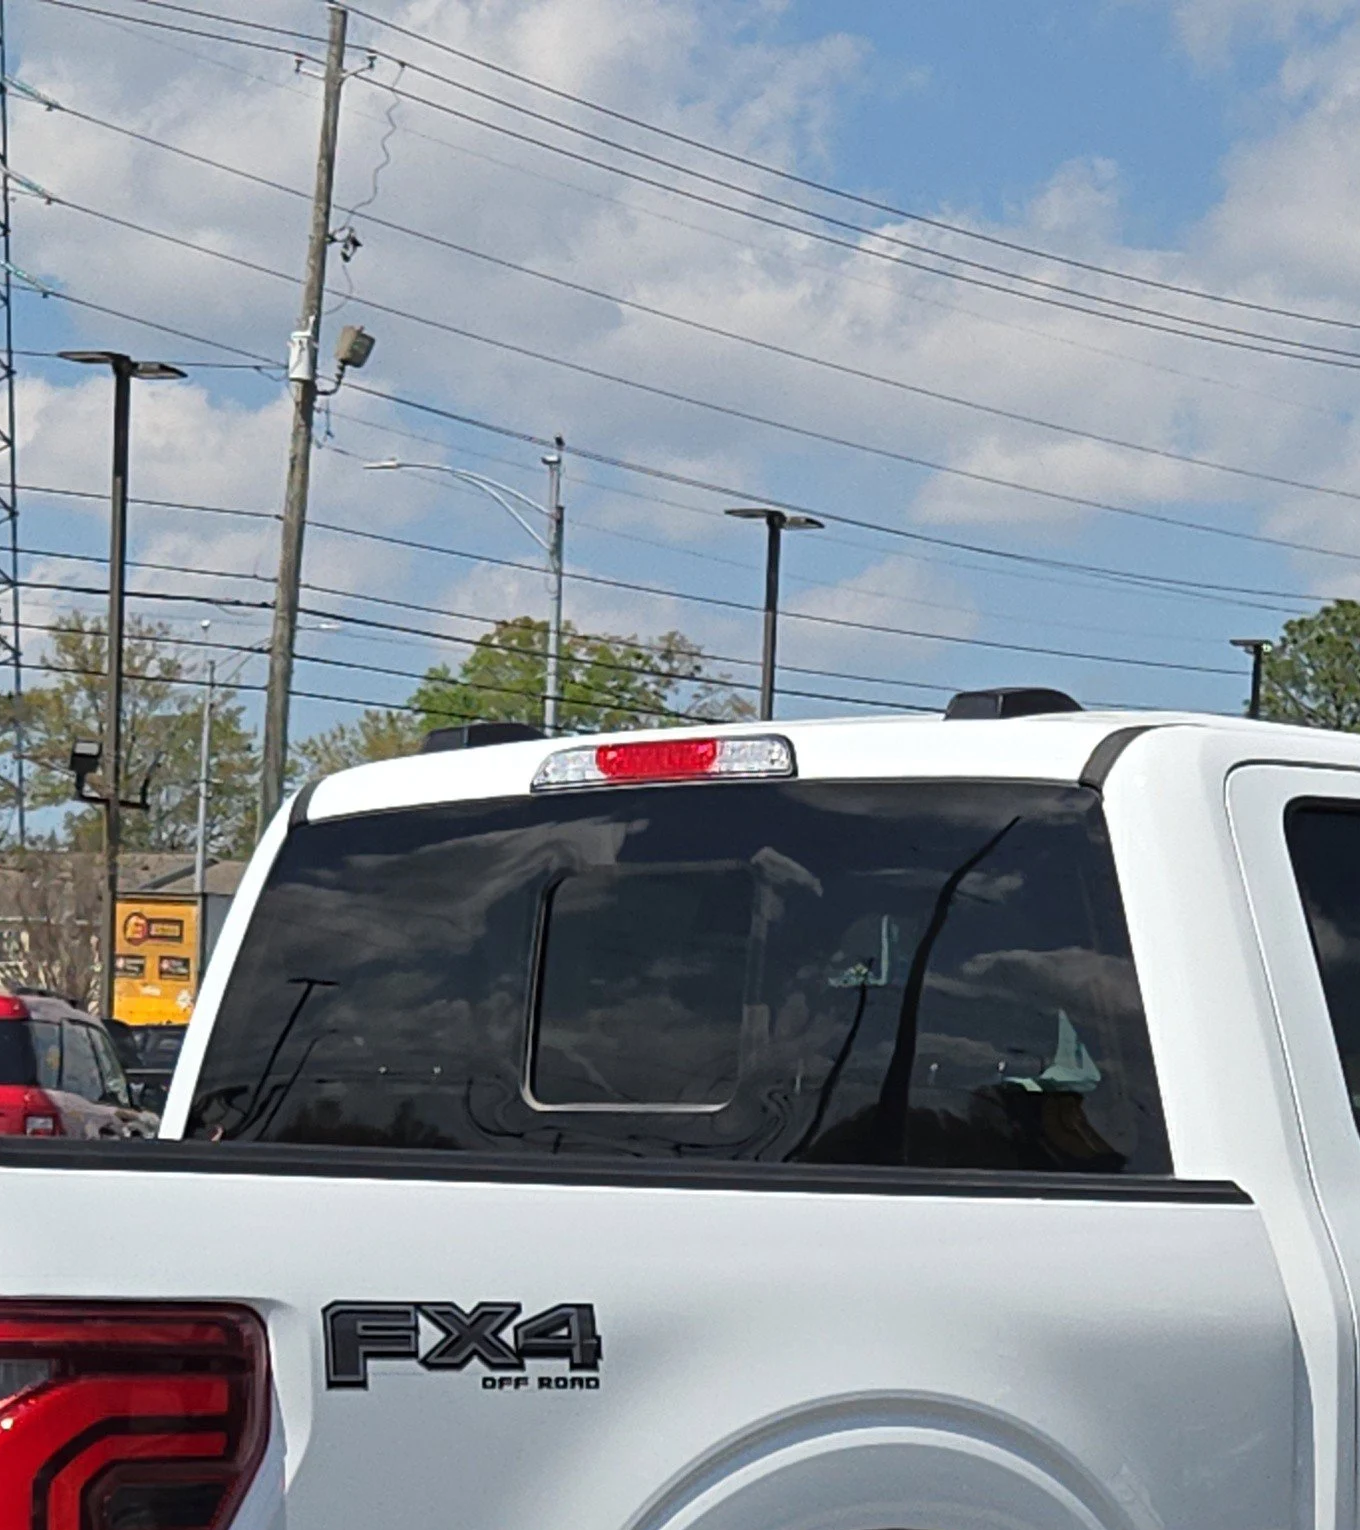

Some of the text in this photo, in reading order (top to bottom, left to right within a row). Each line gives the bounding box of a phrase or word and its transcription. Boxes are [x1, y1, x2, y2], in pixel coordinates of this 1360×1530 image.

[321, 1299, 603, 1390] FX4
[481, 1376, 601, 1390] OFF ROAD
